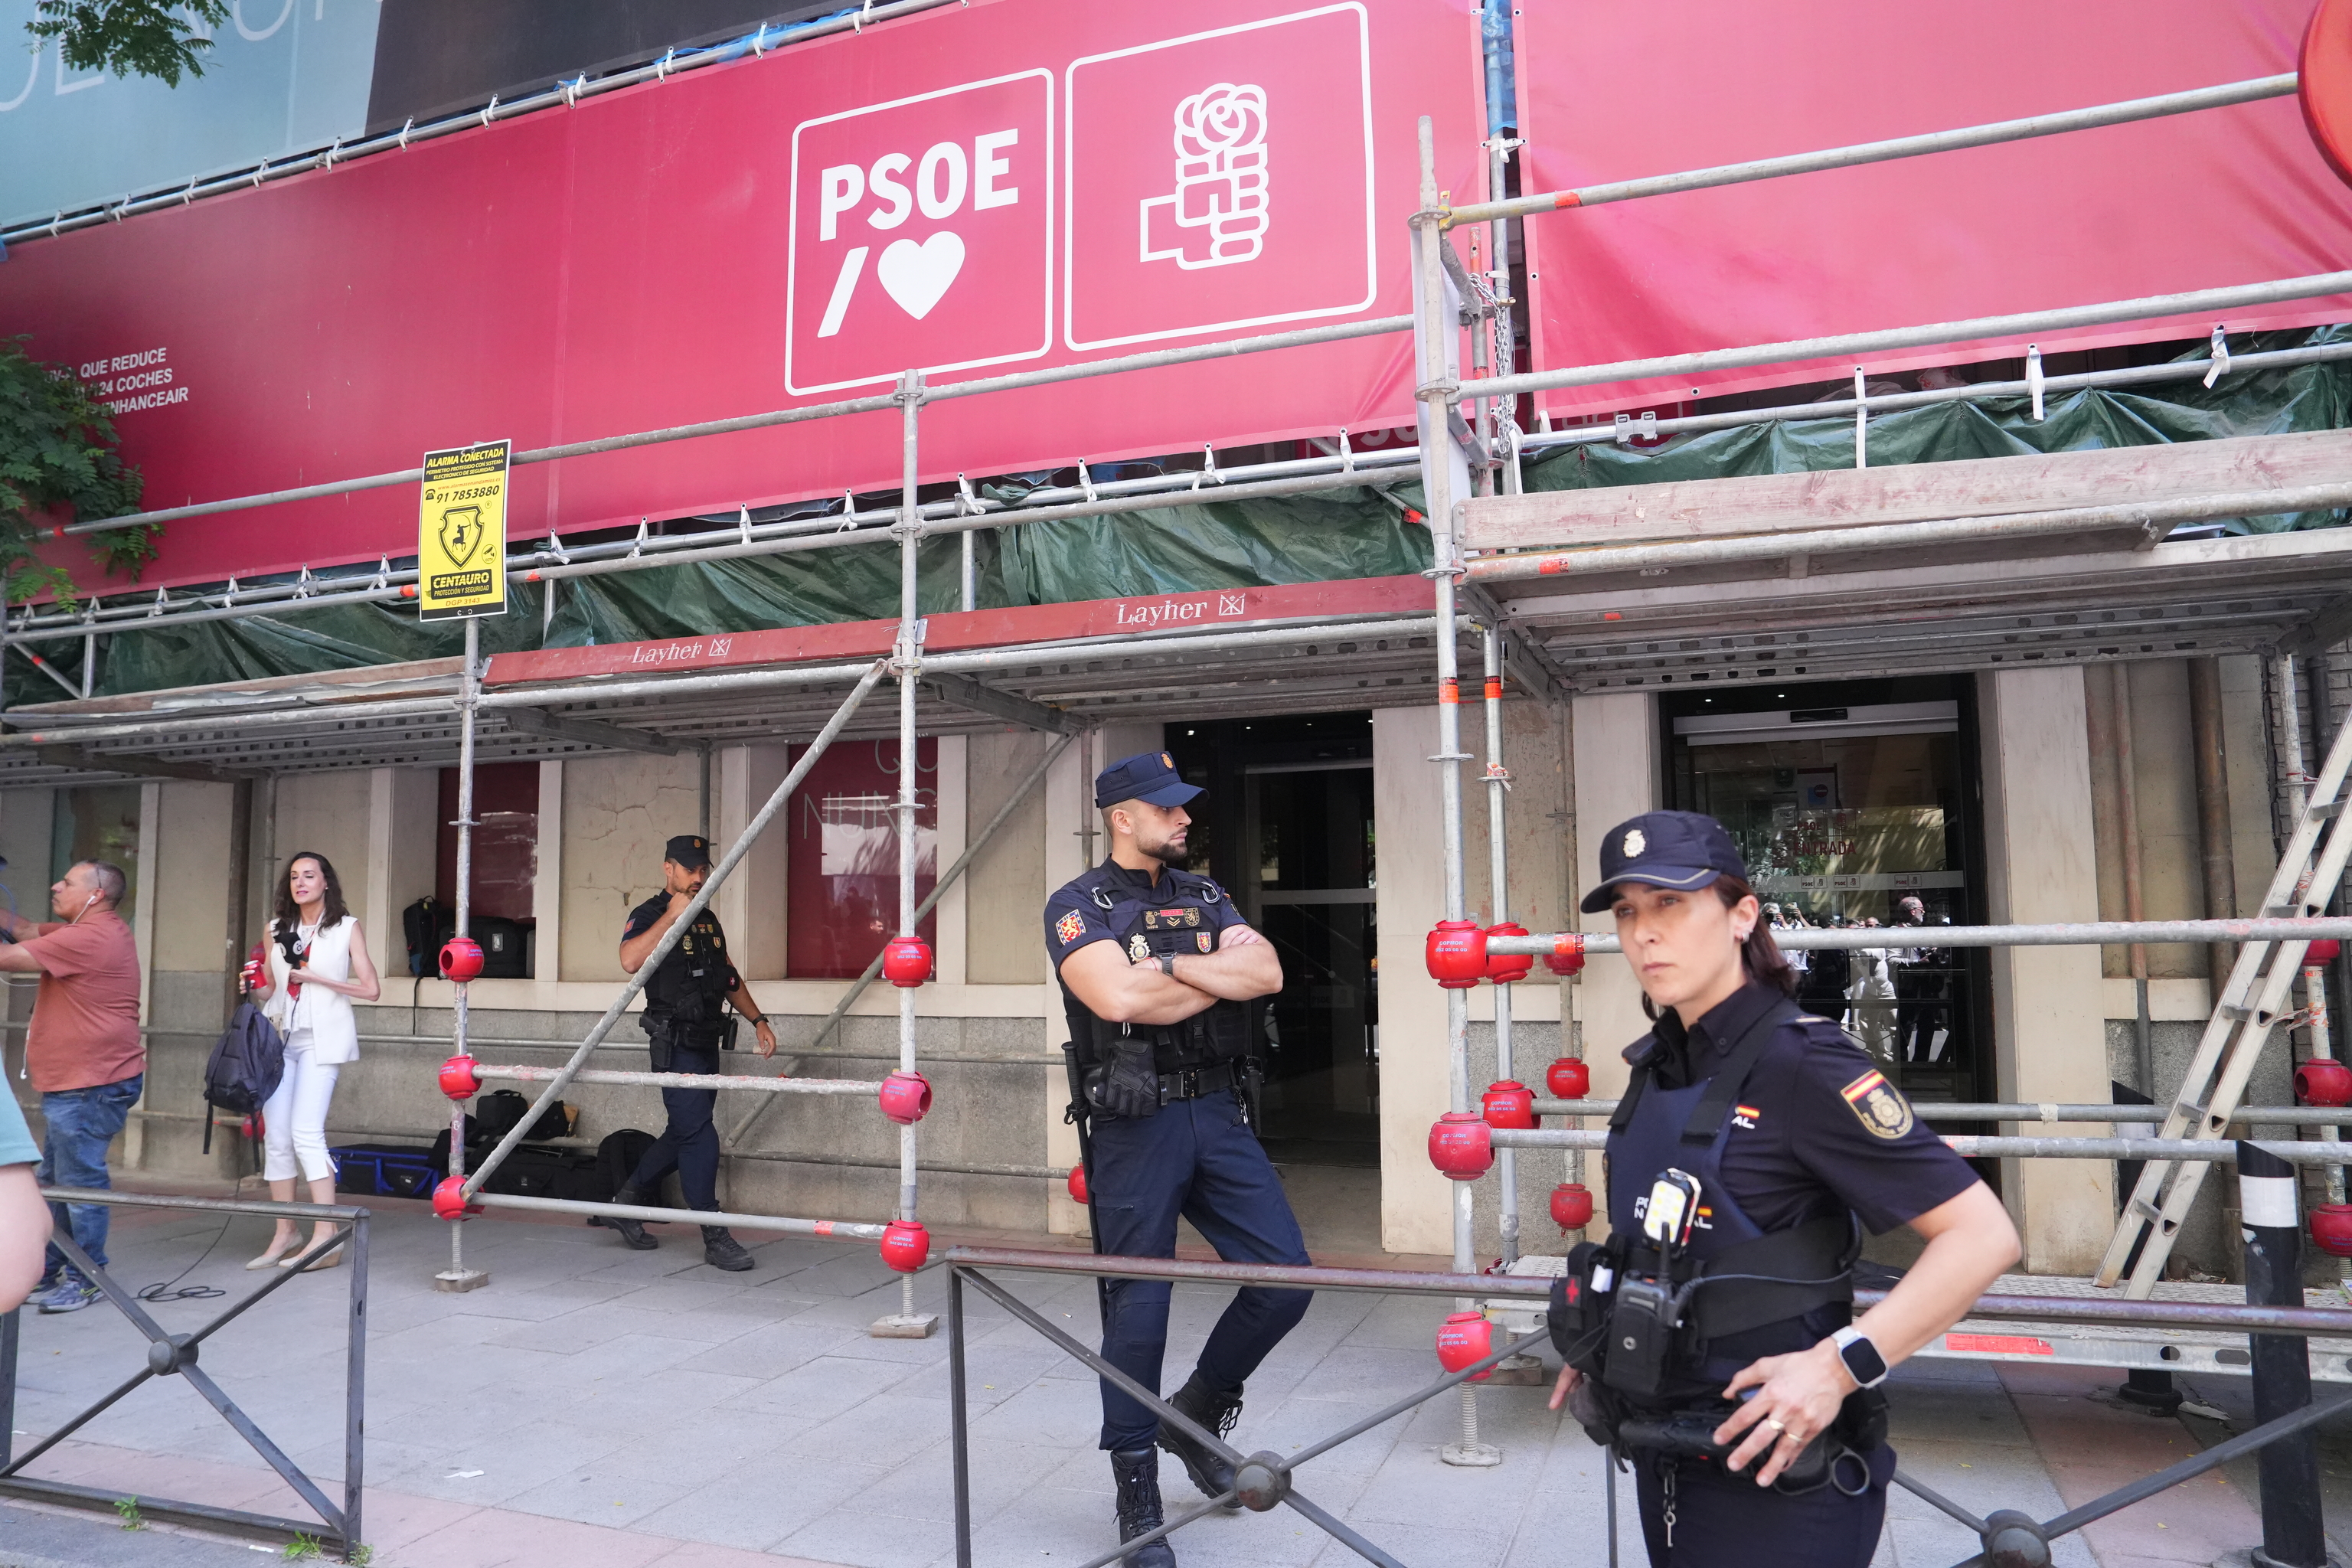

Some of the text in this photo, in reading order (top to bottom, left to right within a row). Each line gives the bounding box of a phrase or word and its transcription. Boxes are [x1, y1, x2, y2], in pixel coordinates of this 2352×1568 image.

[820, 128, 1018, 242] PSOE
[80, 359, 109, 378] QUE
[111, 348, 167, 372] REDUCE
[116, 368, 173, 393] COCHES
[426, 447, 505, 469] ALARMA CONECTADA
[426, 467, 450, 475] PERIMETRO
[450, 463, 475, 472] PROTEGIDO
[485, 459, 504, 467] SISTEMA
[469, 466, 495, 475] SEGURIDAD
[436, 485, 500, 504] 91 7853880
[433, 572, 490, 589] CENTAURO
[433, 587, 461, 596] PROTECCIÓN
[465, 585, 490, 594] SEGURIDAD
[1116, 599, 1207, 626] Layher
[632, 642, 703, 665] Layher
[1793, 841, 1857, 856] ENTRADA
